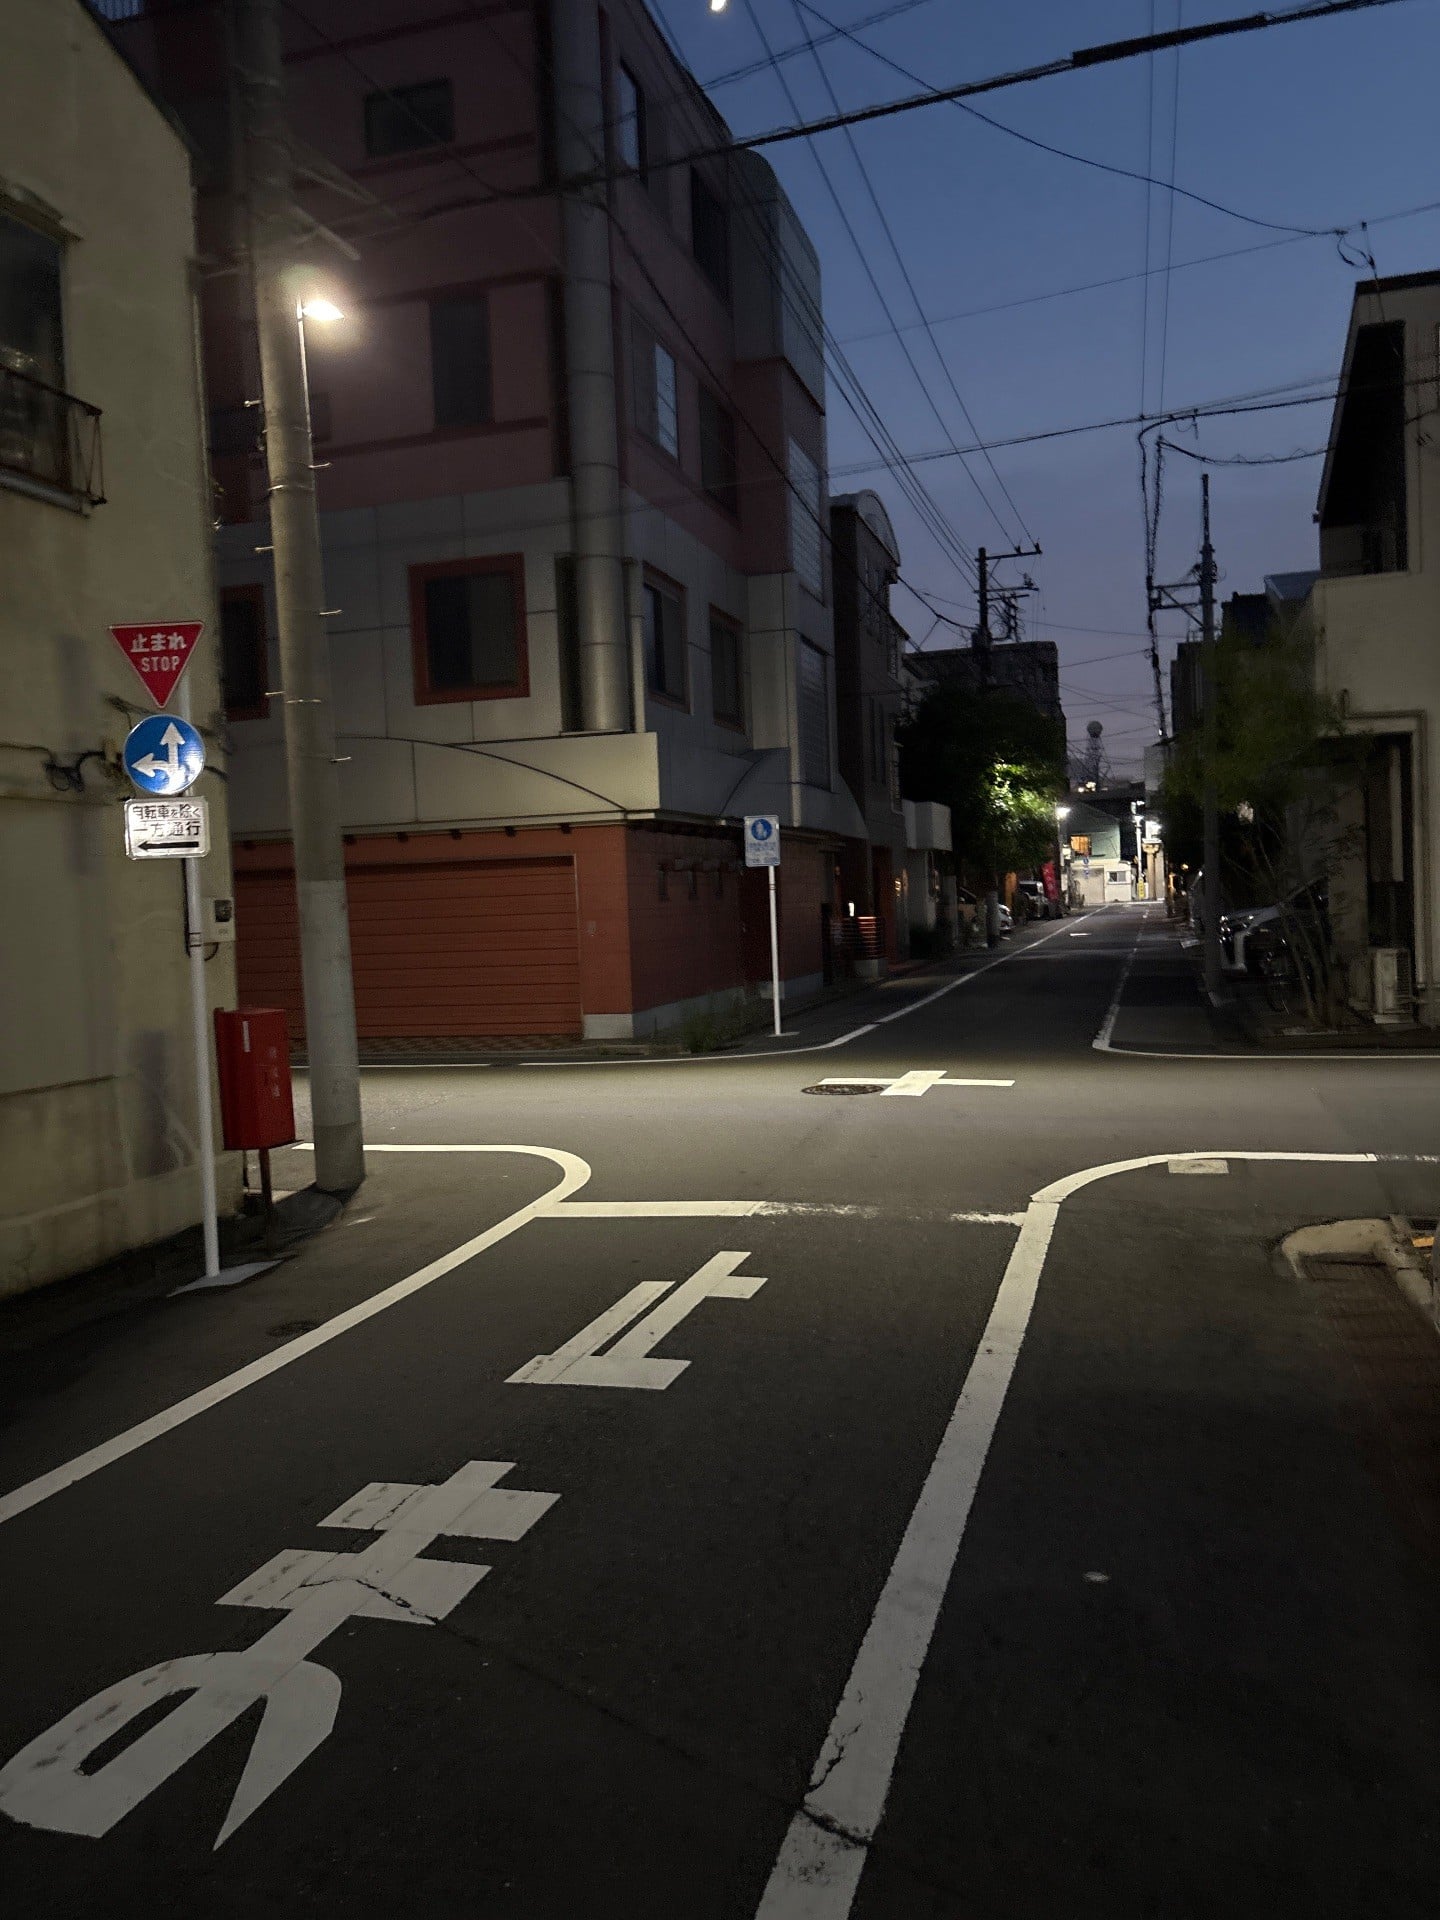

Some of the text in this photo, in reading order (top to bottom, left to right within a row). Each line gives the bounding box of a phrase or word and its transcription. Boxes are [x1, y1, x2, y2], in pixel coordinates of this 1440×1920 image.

[130, 632, 187, 653] 止まれ
[140, 656, 181, 673] STOP
[132, 804, 201, 820] 自転車を除く
[132, 821, 201, 837] 一方通行
